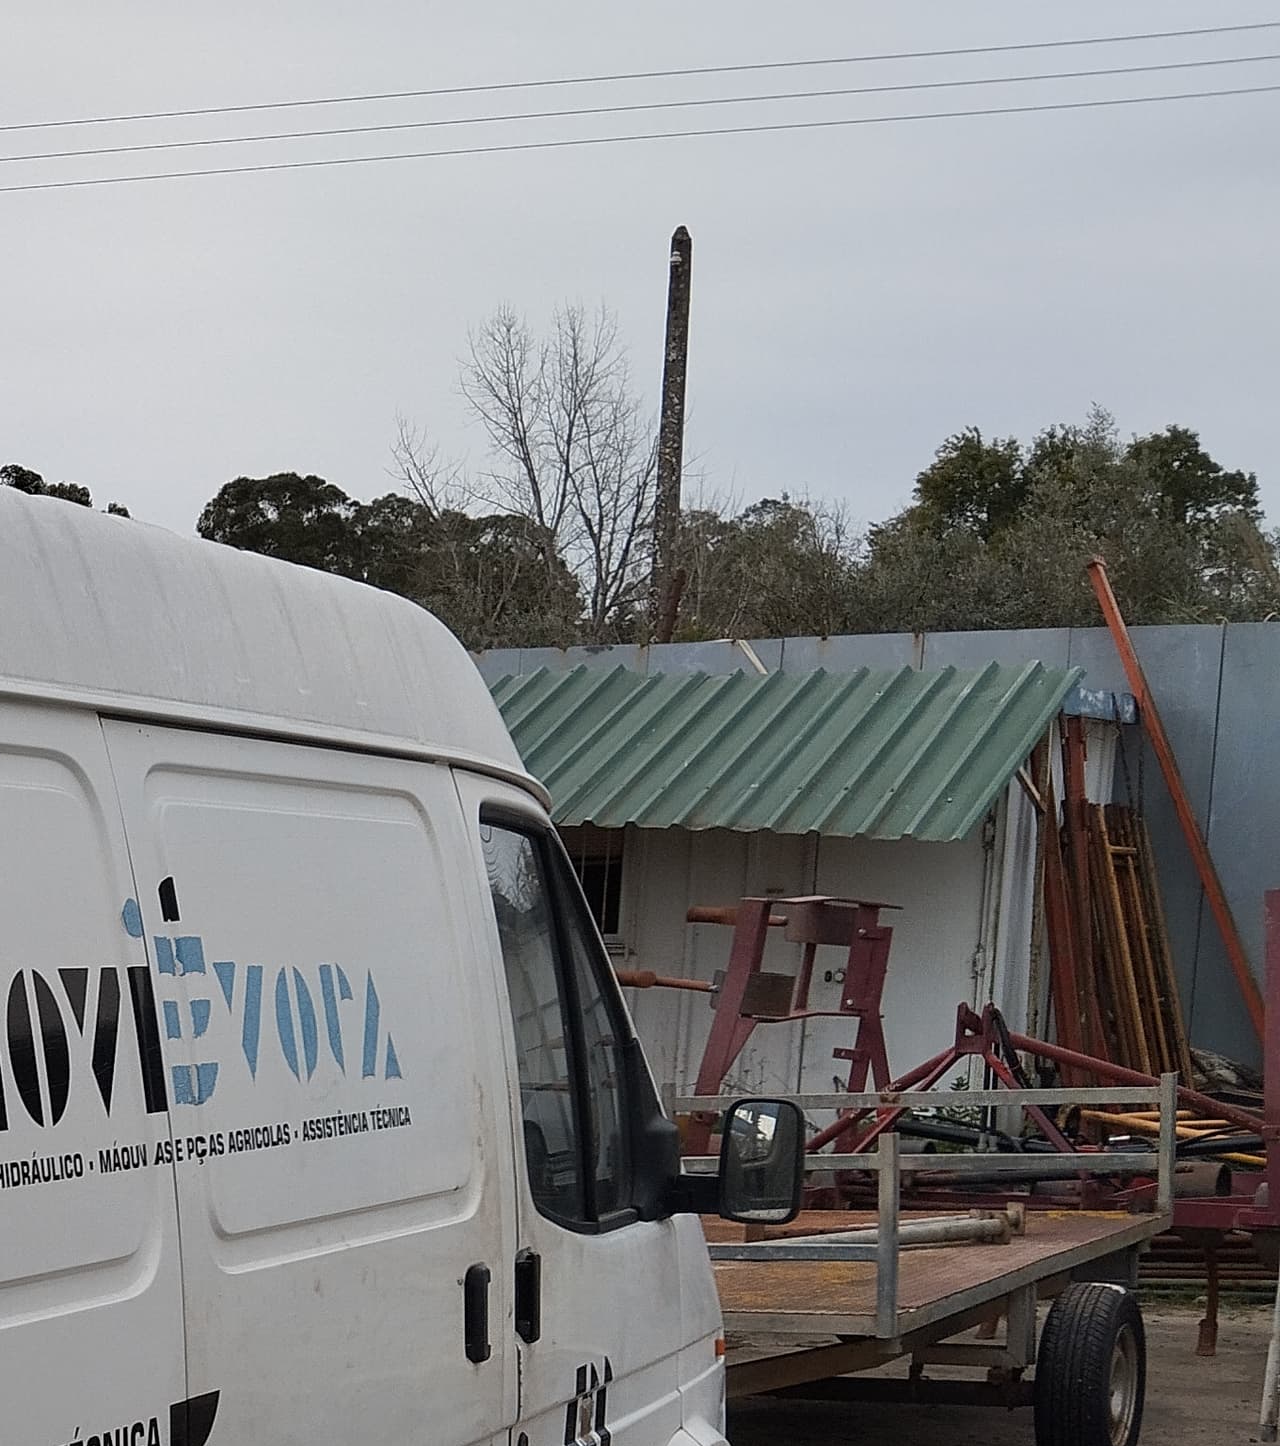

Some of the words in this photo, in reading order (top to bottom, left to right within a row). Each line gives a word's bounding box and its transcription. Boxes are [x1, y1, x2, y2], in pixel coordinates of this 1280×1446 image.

[228, 1123, 291, 1154] AGRICOLAS
[302, 1109, 370, 1142] ASSISTÊNCIA
[370, 1103, 412, 1131] TÉCNICA
